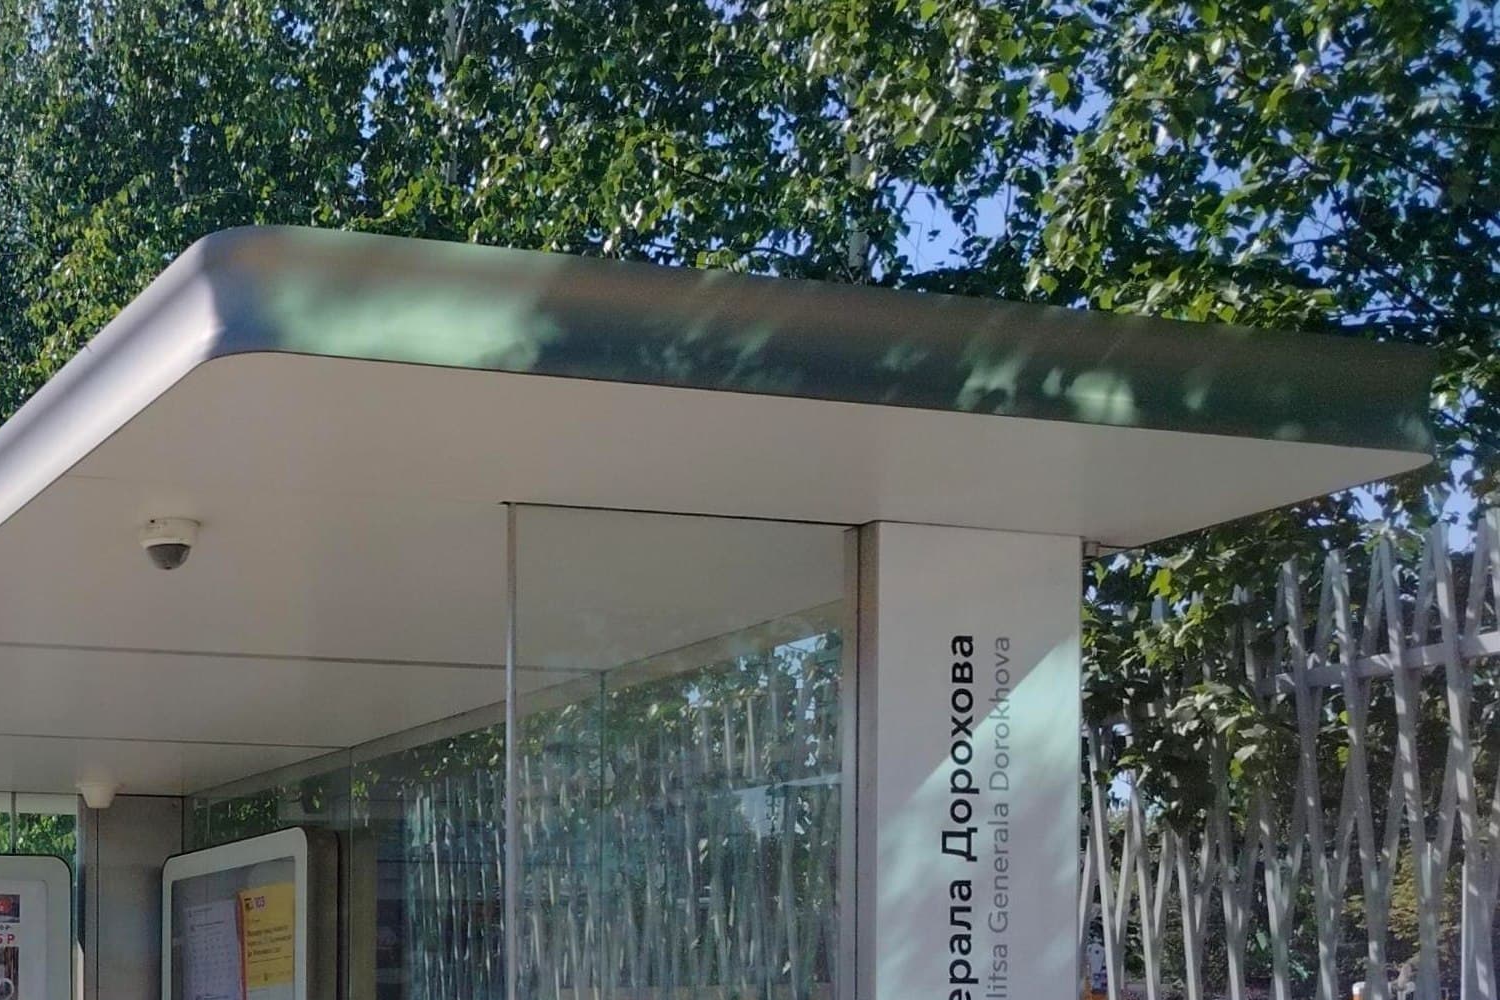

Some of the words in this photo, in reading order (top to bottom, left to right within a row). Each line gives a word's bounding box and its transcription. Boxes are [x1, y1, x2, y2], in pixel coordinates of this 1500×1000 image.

[941, 635, 980, 863] Дорохова
[988, 637, 1010, 791] Dorokhova
[987, 802, 1010, 933] Generala
